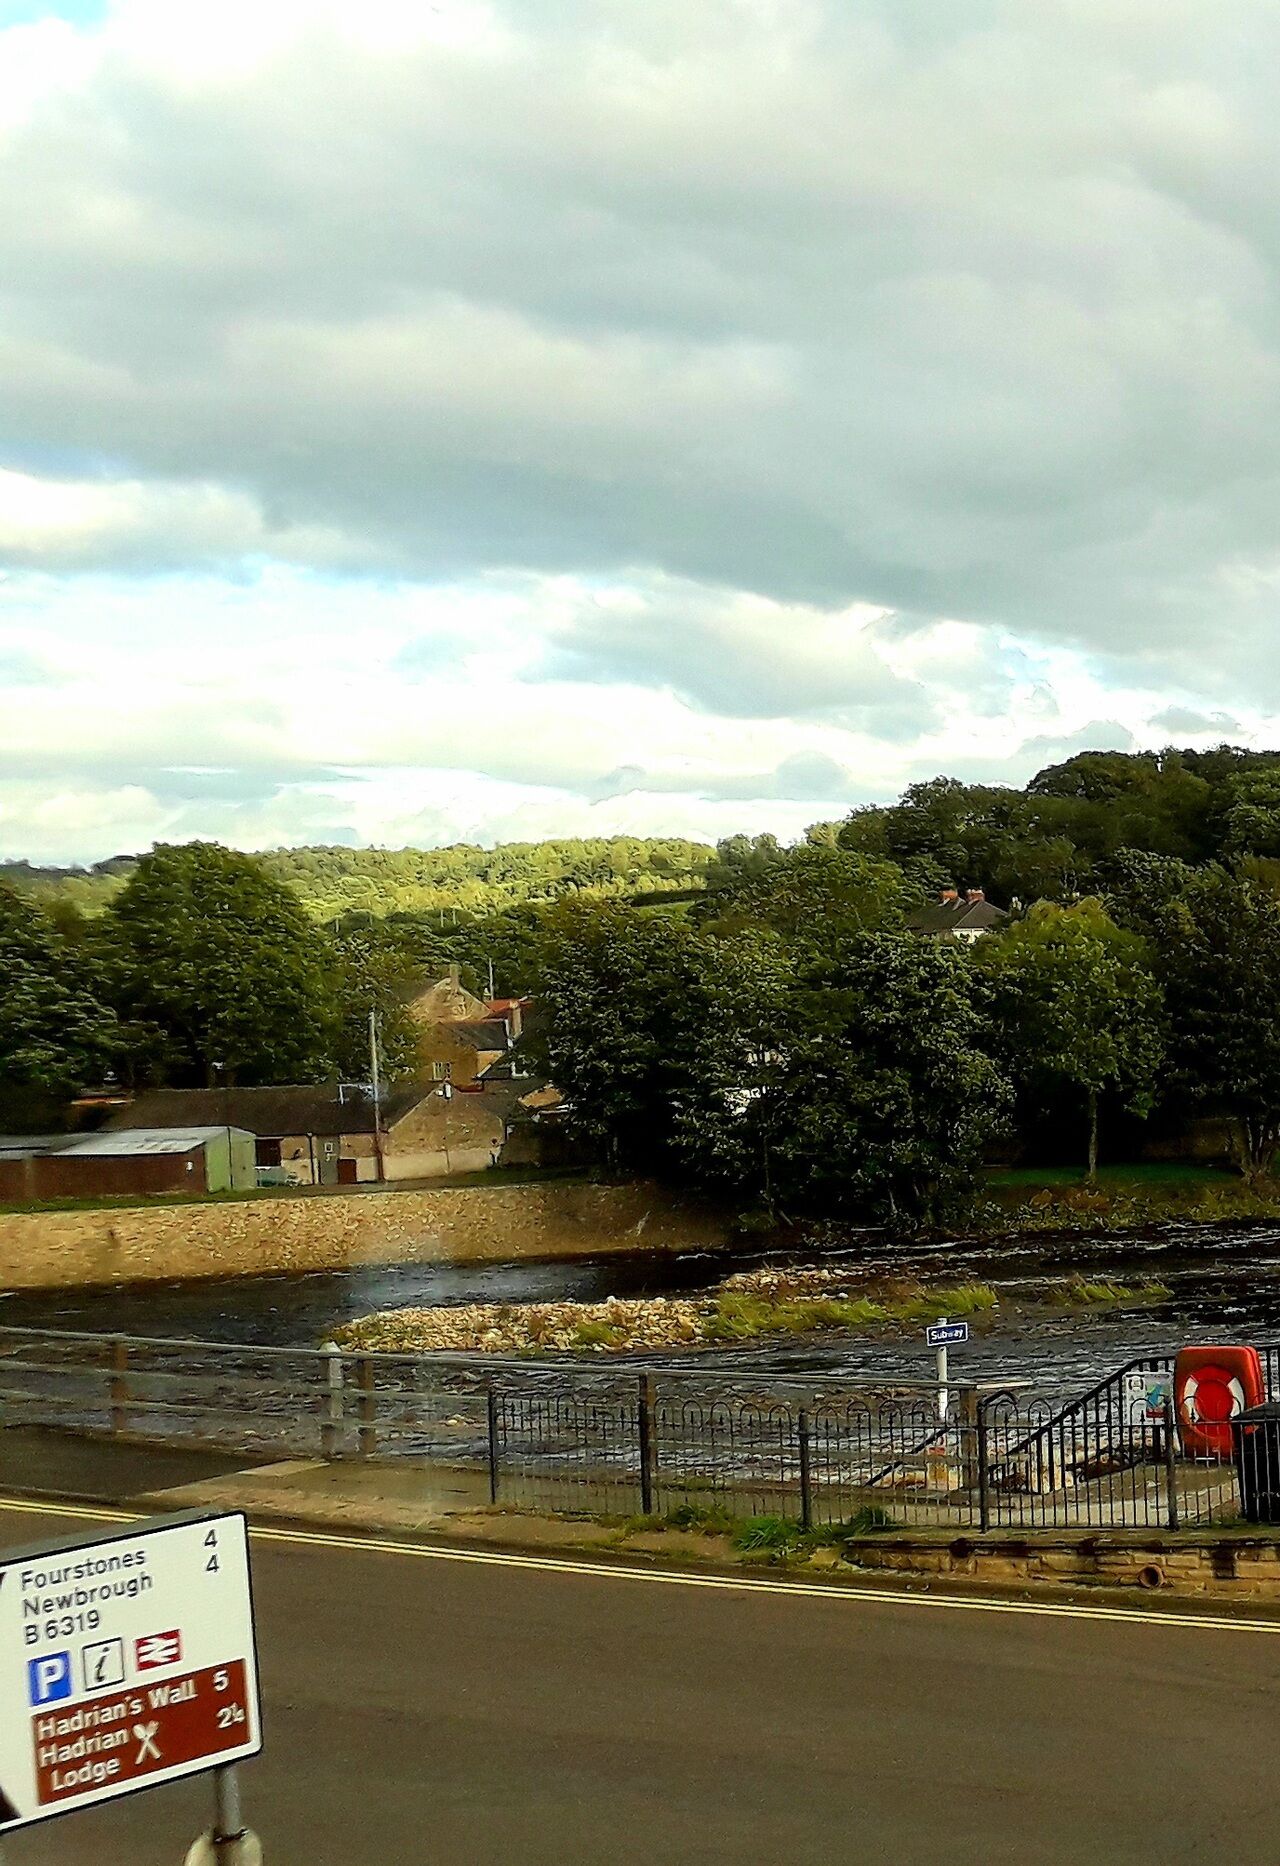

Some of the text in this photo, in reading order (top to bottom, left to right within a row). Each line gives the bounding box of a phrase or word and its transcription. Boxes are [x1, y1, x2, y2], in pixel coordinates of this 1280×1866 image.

[21, 1529, 218, 1591] Fourstones 4
[23, 1553, 220, 1618] Newbrough 4
[37, 1670, 229, 1741] Hadrian's Wall 5
[39, 1727, 129, 1768] Hadrian
[51, 1756, 121, 1792] Lodge
